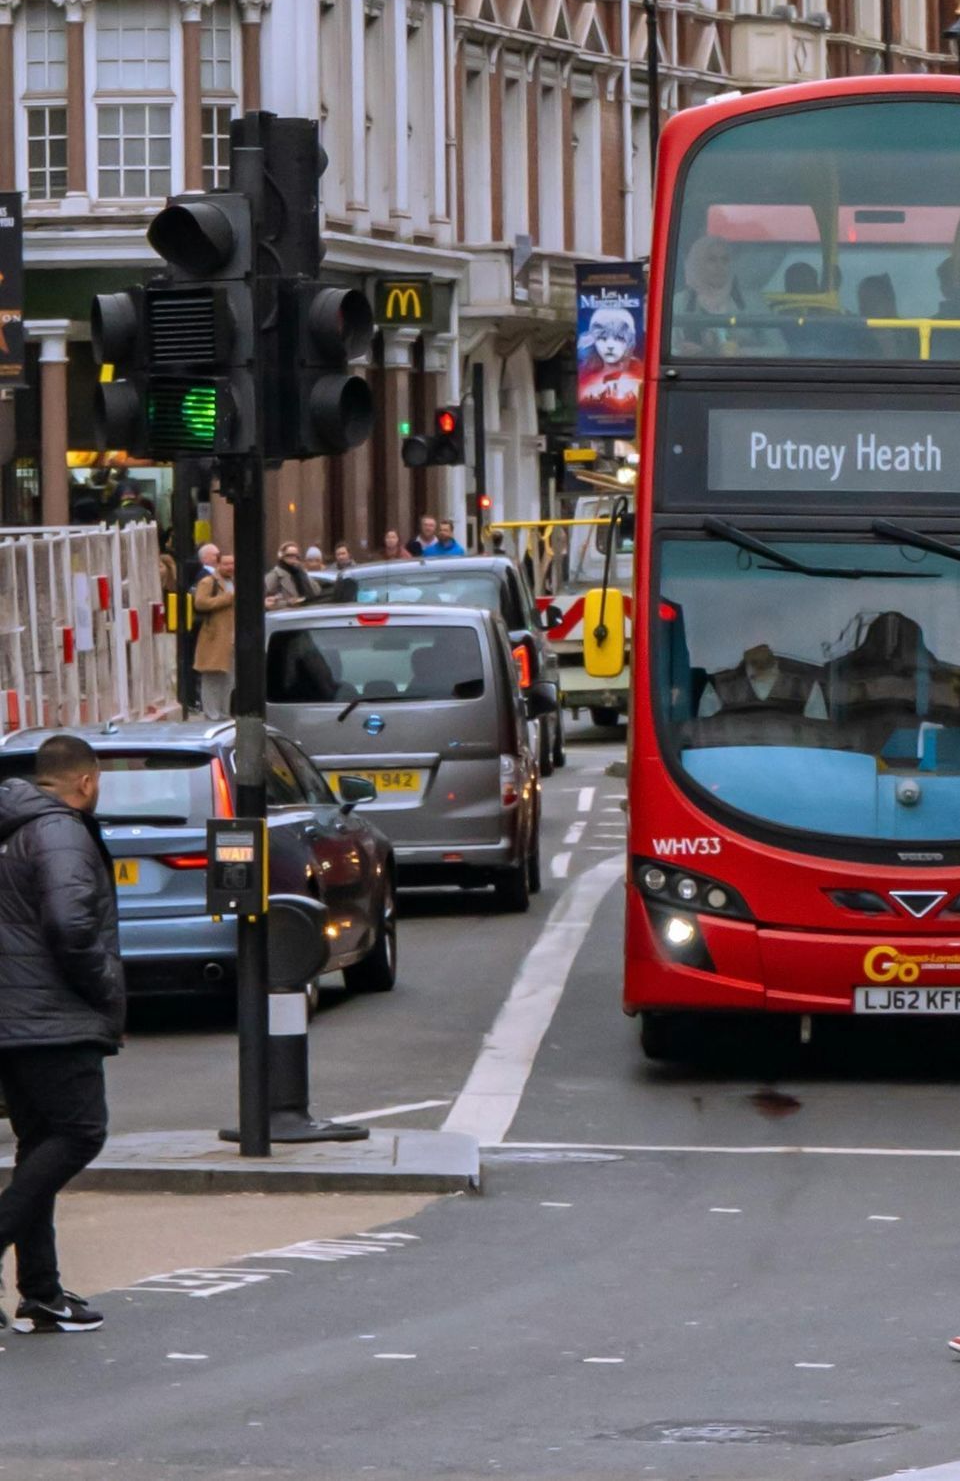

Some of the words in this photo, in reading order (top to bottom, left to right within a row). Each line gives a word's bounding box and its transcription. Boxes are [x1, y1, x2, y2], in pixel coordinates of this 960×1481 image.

[751, 431, 845, 482] Putney
[857, 433, 941, 472] Heath
[653, 838, 721, 856] WHV33
[865, 990, 919, 1010] LJ62
